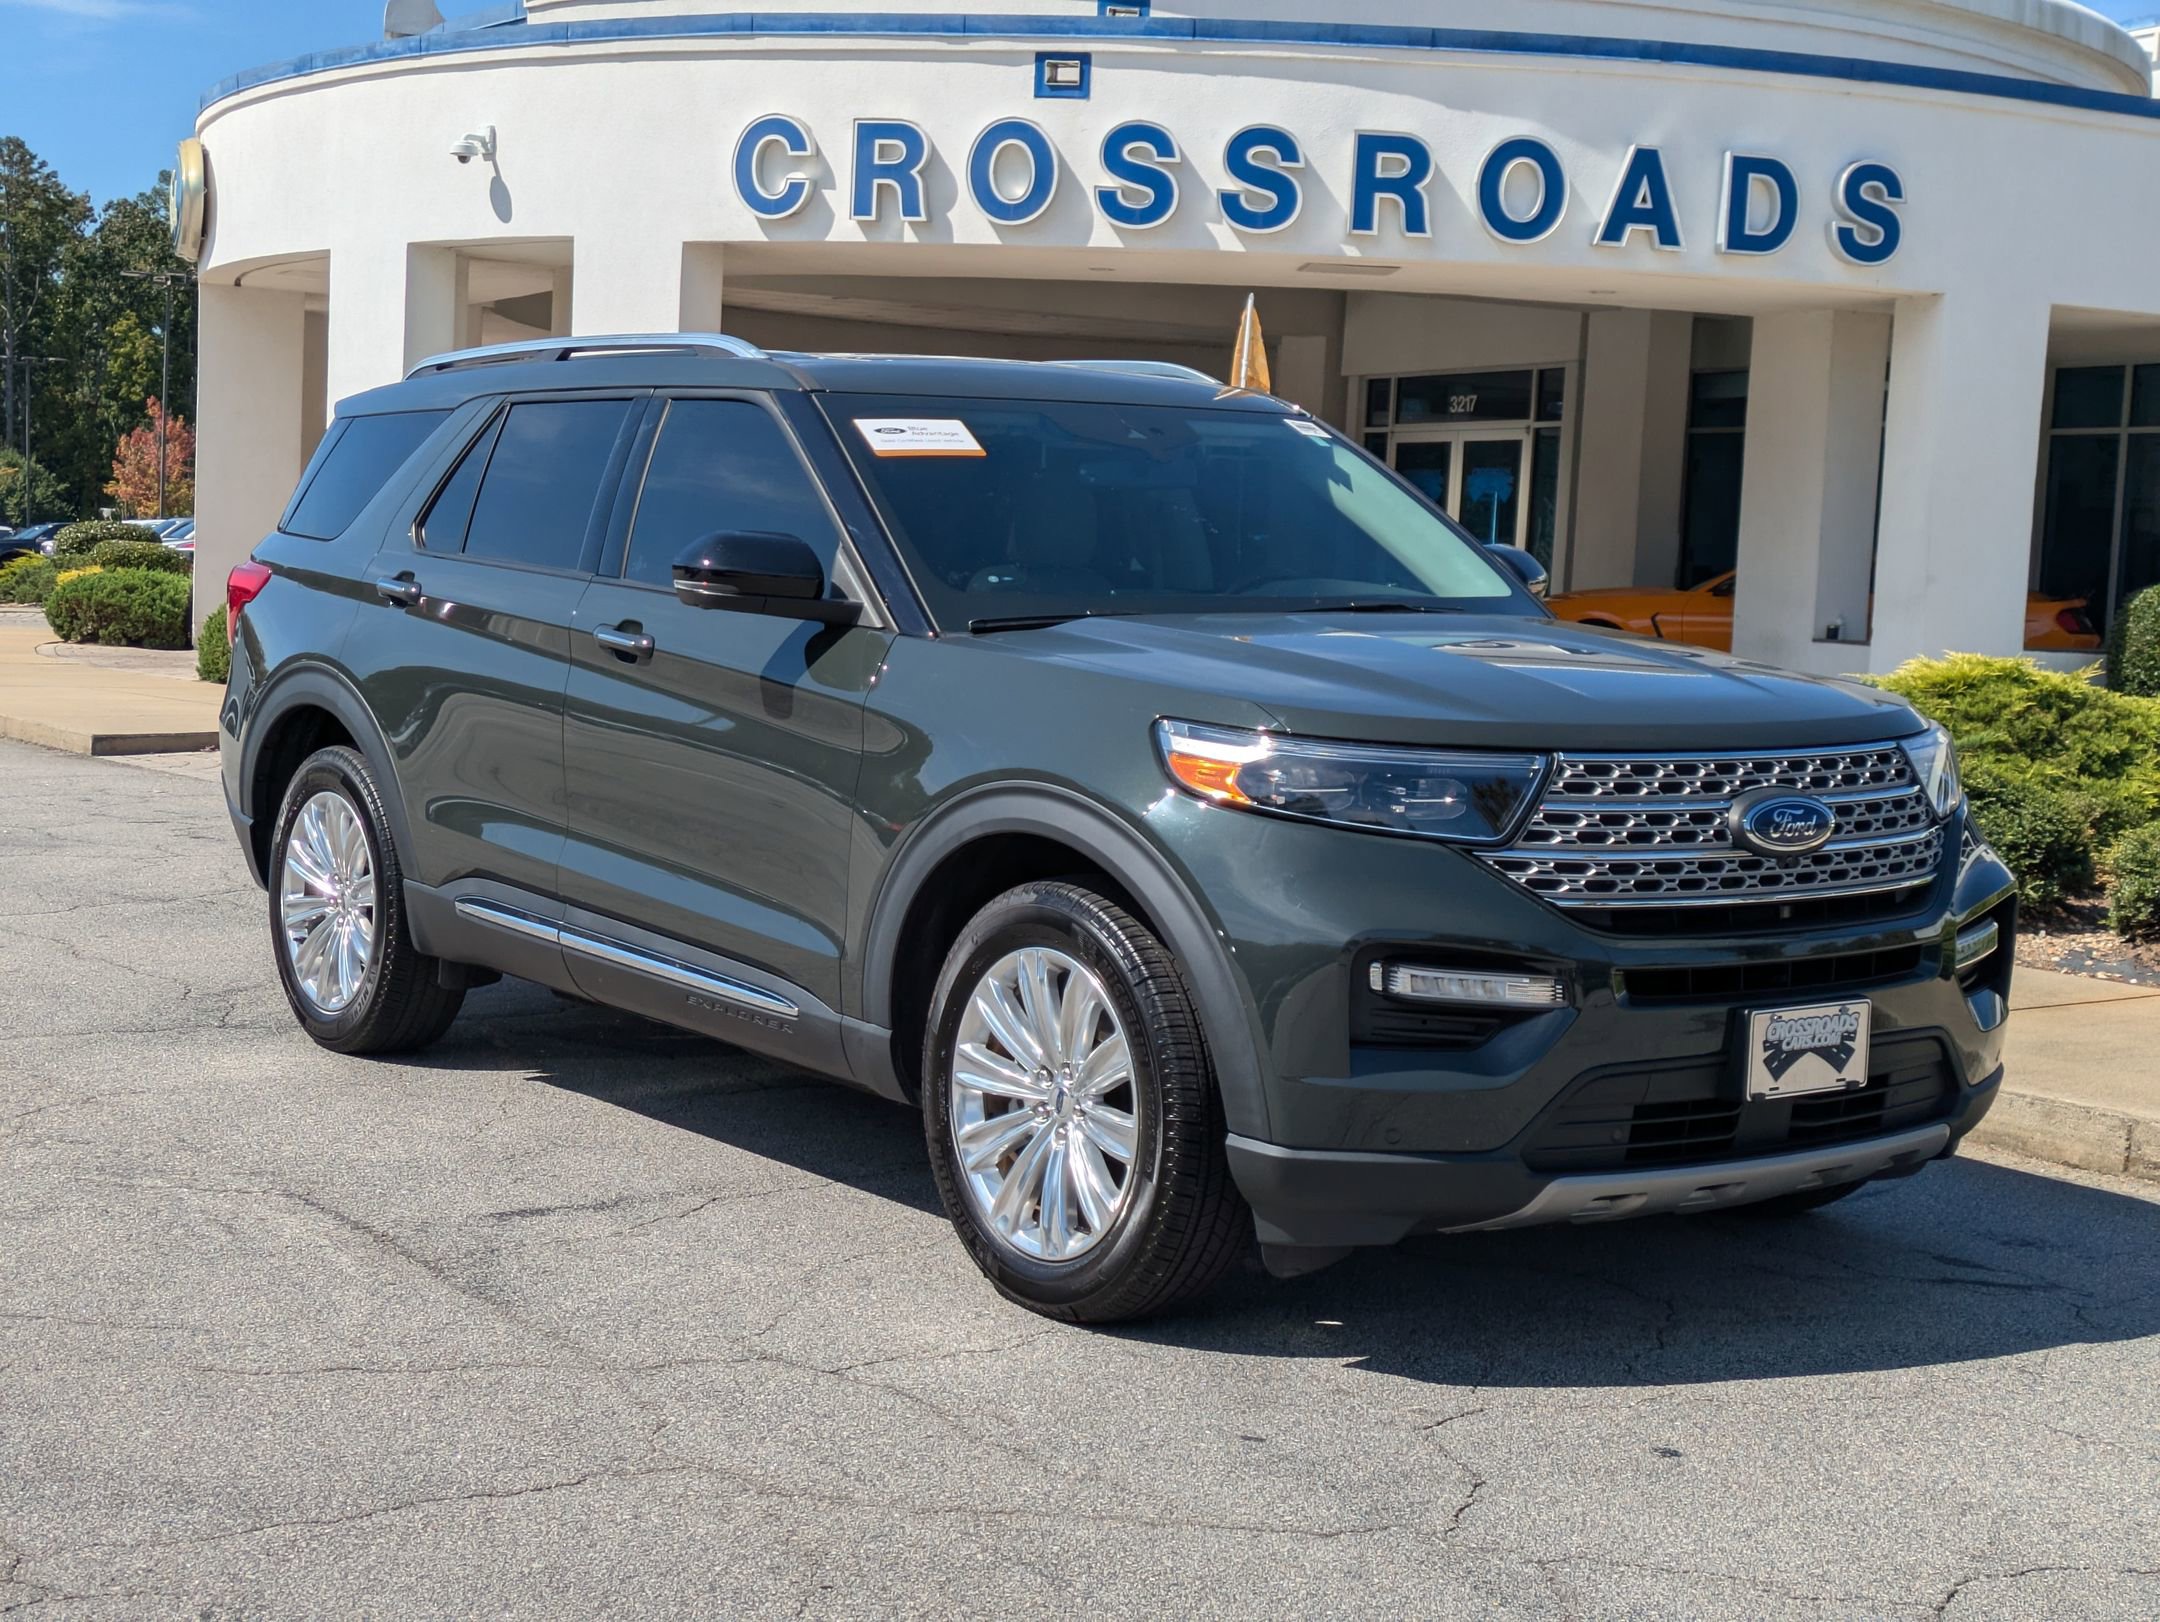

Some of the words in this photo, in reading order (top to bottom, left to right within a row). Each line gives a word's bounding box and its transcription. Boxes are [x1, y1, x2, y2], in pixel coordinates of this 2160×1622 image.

[732, 113, 1904, 265] CROSSROADS
[1450, 395, 1478, 413] 3217
[1769, 808, 1817, 838] Ford
[686, 994, 793, 1034] EXPLORER
[1766, 1011, 1860, 1040] CROSSROADS
[1782, 1032, 1842, 1051] CARS.COM
[934, 1142, 975, 1241] MICHELIN
